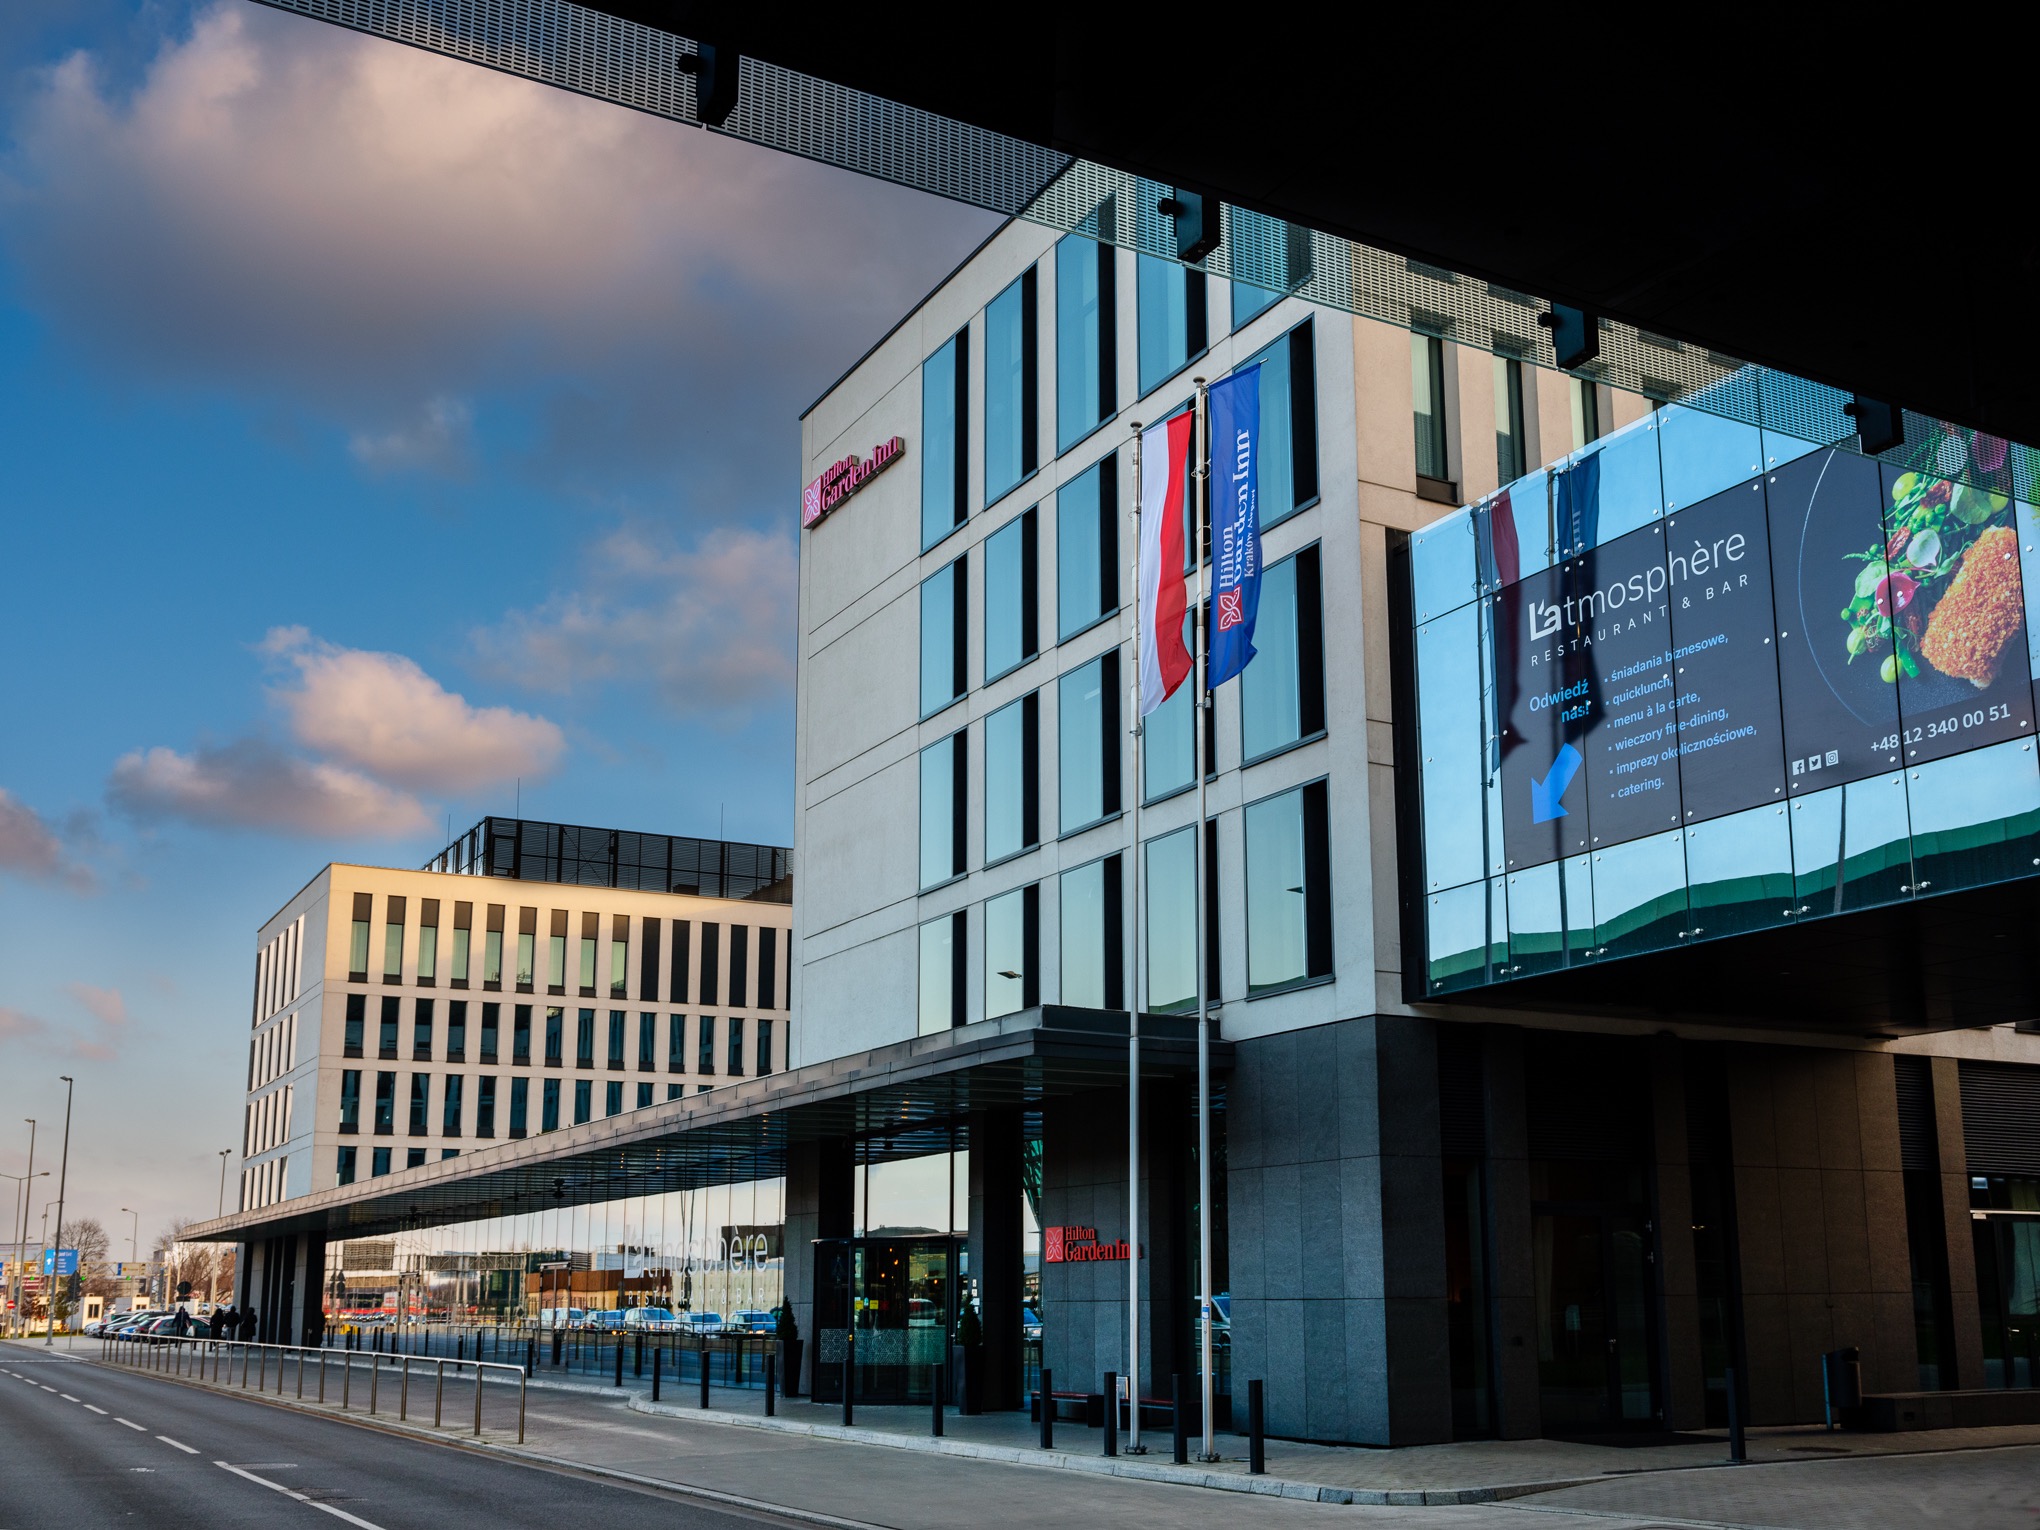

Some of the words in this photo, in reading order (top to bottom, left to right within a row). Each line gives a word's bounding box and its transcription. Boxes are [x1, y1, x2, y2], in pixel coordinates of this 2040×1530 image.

[822, 459, 872, 511] Garden
[872, 436, 900, 471] Inn
[823, 454, 857, 488] Hilton
[1219, 525, 1234, 589] Hilton
[1244, 532, 1255, 577] Kraków
[1531, 605, 1667, 667] RESTAURANT
[1682, 597, 1691, 609] &
[1706, 574, 1749, 600] BAR
[1611, 656, 1663, 682] śniadania
[1665, 632, 1729, 662] biznesowe,
[1529, 678, 1589, 712] Odwiedź
[1612, 676, 1674, 706] quicklunch,
[1614, 711, 1644, 729] menu
[1646, 703, 1653, 717] à
[1656, 699, 1666, 714] la
[1668, 691, 1701, 710] carte,
[1561, 701, 1590, 723] nas!
[1615, 727, 1663, 752] wieczory
[1665, 707, 1729, 734] fine-dining,
[1870, 734, 1899, 752] +48
[1903, 727, 1923, 745] 12
[1927, 717, 1959, 738] 340
[1962, 710, 1984, 729] 00
[1989, 703, 2011, 722] 51
[1616, 754, 1659, 777] imprezy
[1661, 724, 1757, 761] okolicznościowe,
[1618, 776, 1665, 800] catering.
[1065, 1225, 1095, 1240] Hilton
[1065, 1240, 1115, 1262] Garden
[628, 1288, 715, 1306] RESTAURANT
[736, 1287, 765, 1305] BAR
